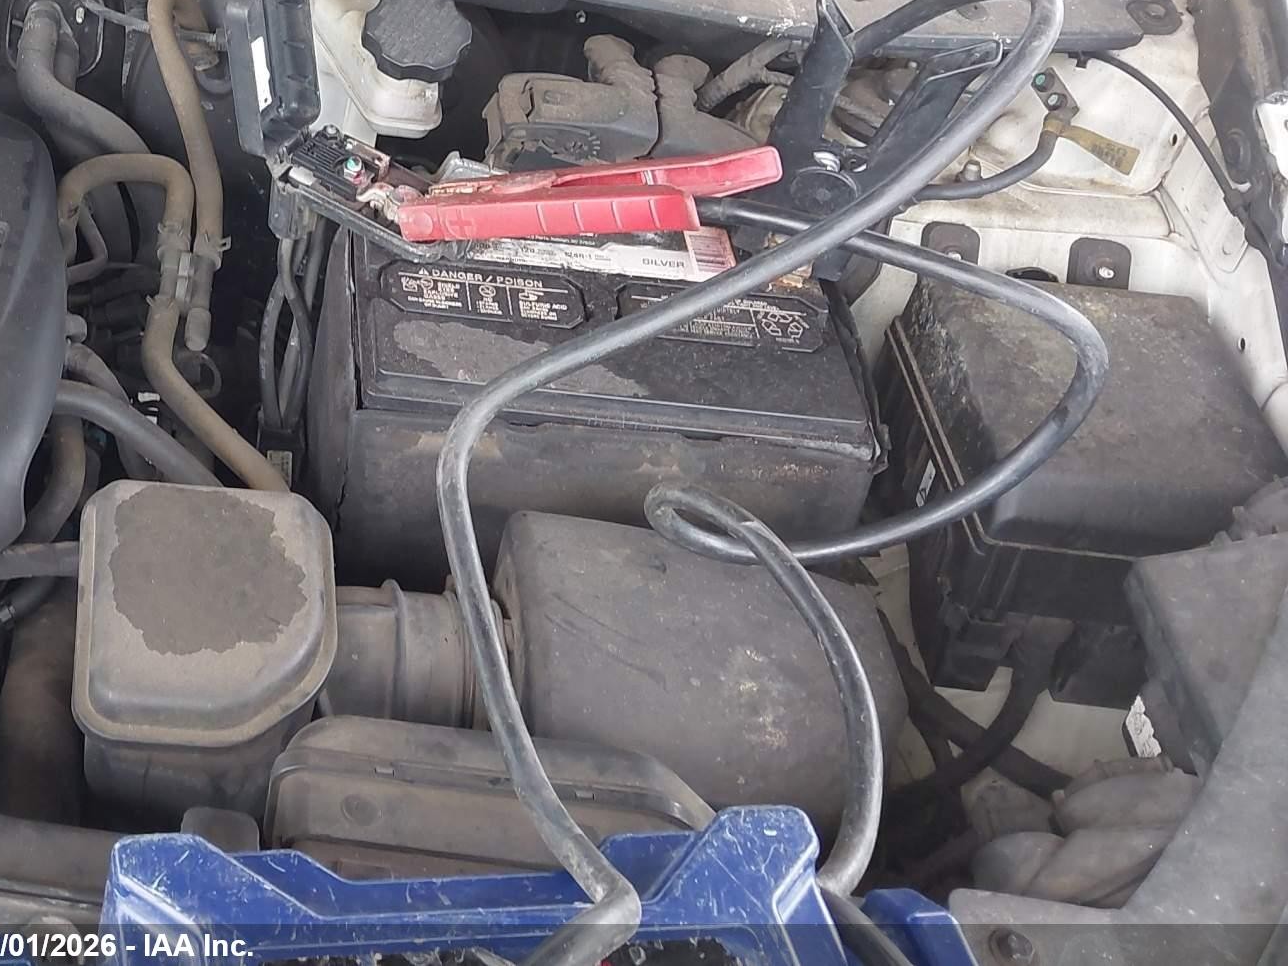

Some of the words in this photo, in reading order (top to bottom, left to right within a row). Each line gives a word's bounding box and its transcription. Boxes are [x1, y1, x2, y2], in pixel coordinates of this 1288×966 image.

[641, 257, 686, 269] SILVER
[431, 268, 483, 282] DANGER
[496, 277, 543, 288] POISON
